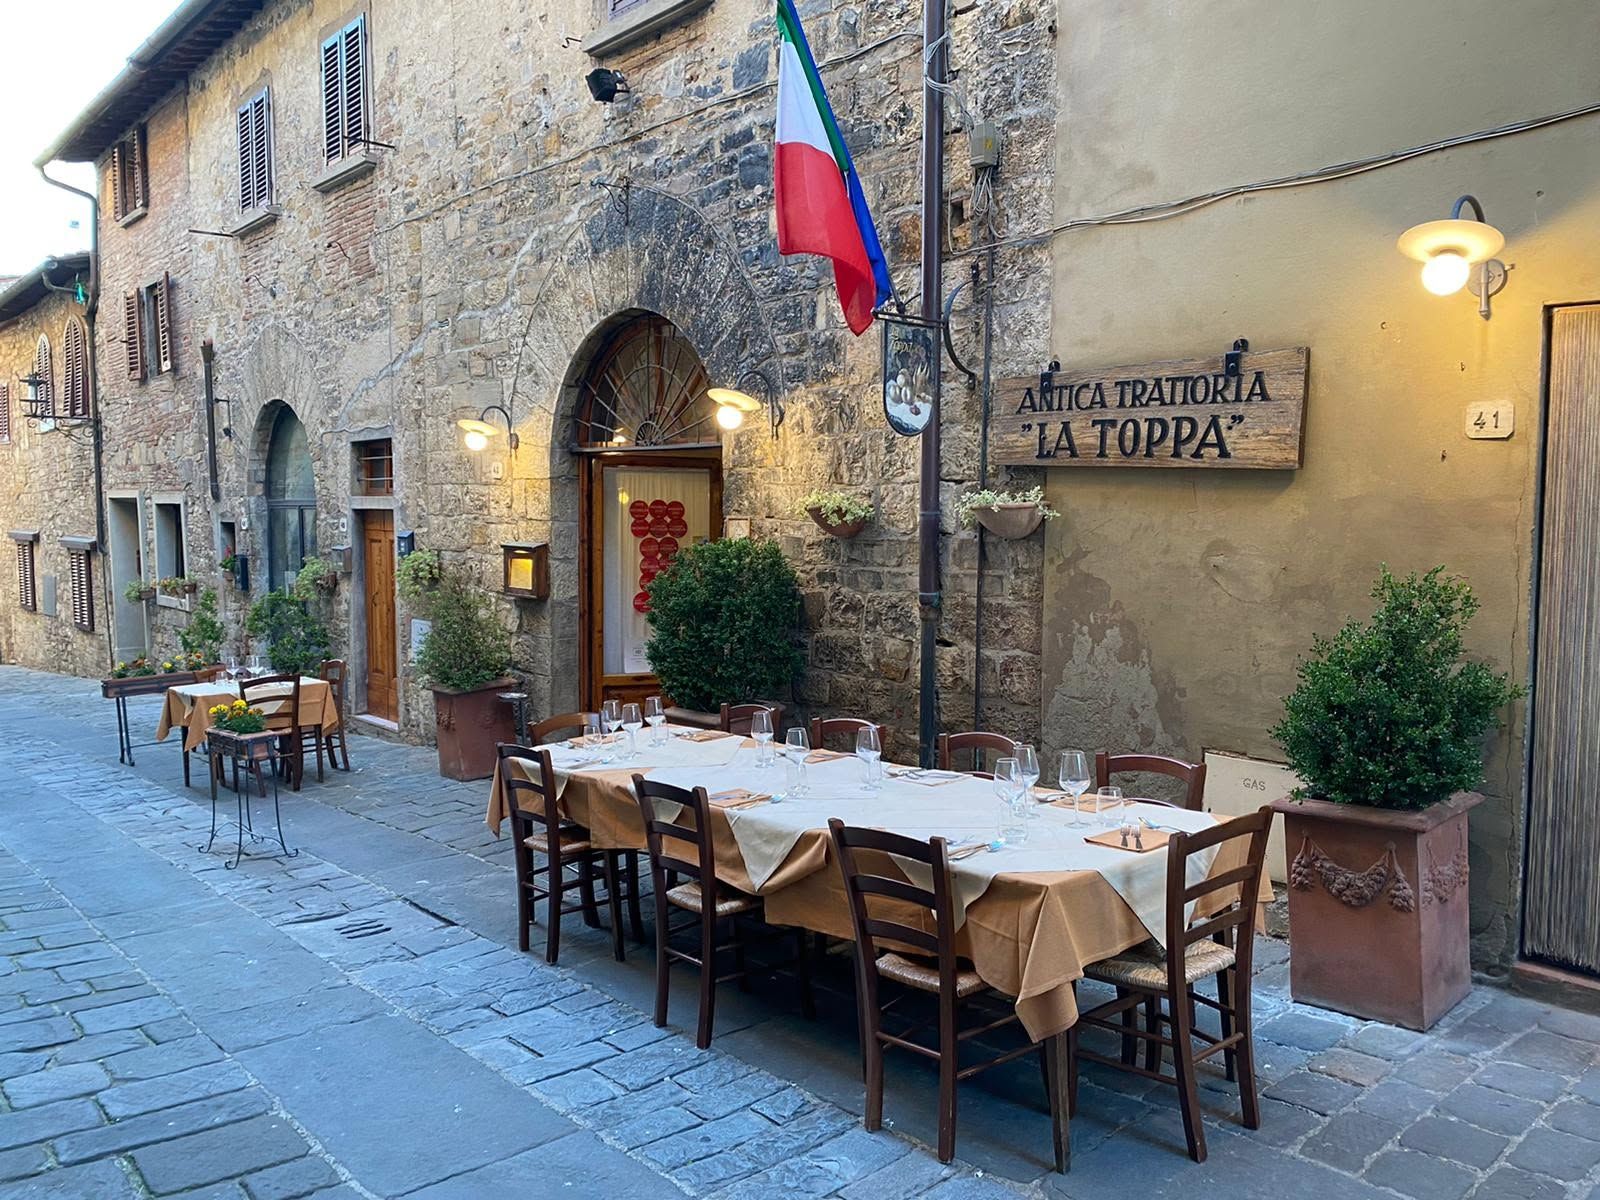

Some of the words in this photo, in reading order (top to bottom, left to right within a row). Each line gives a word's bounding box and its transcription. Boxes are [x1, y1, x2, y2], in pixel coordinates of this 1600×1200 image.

[1016, 382, 1108, 414] ANTICA
[1114, 370, 1272, 408] TRATTORIA
[1473, 411, 1499, 429] 41
[1242, 777, 1267, 791] GAS
